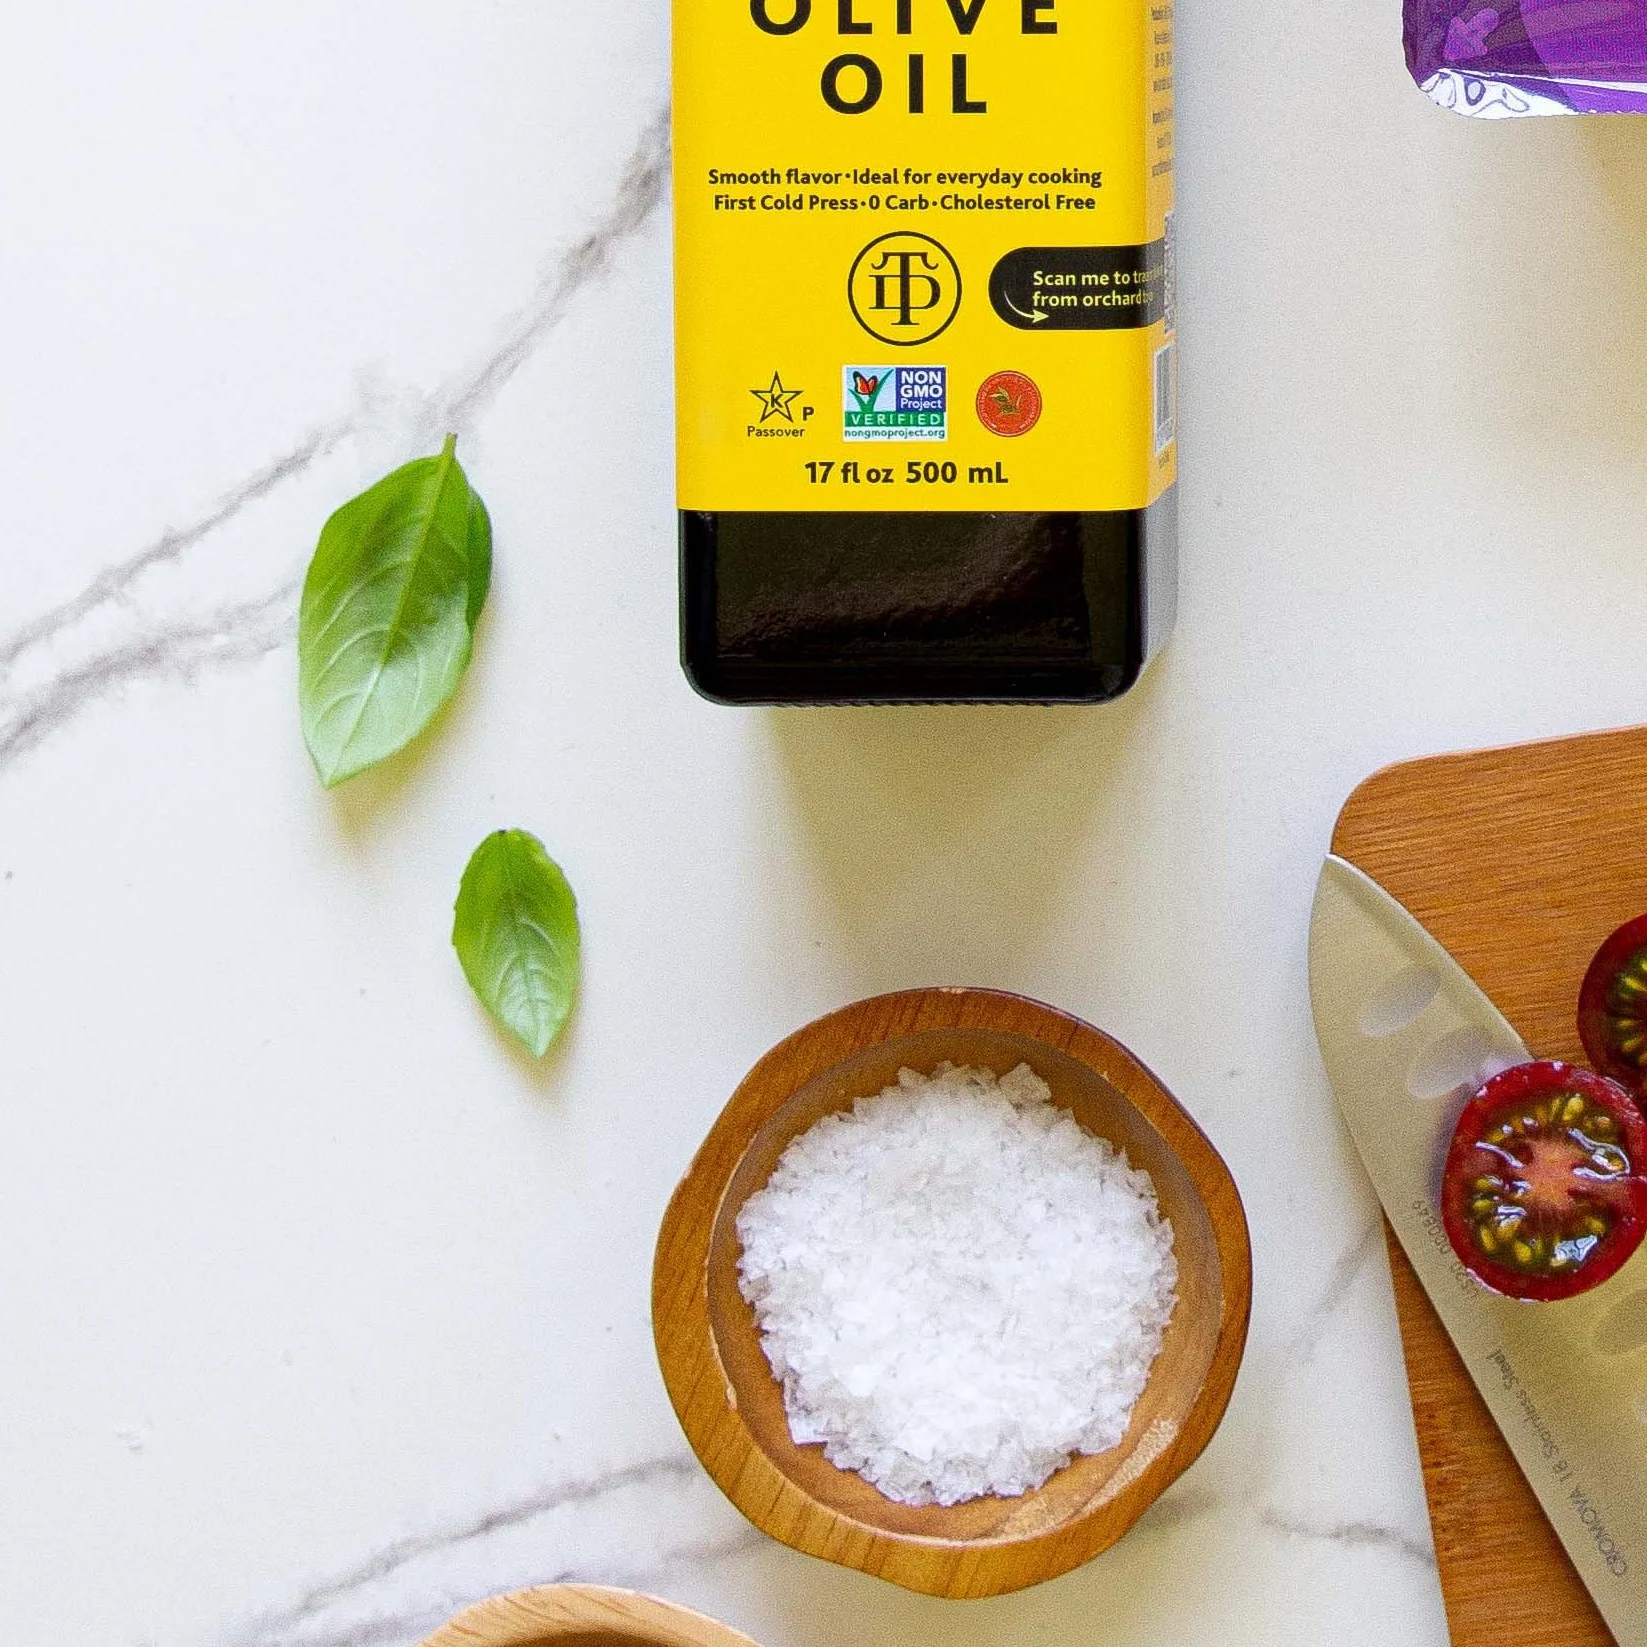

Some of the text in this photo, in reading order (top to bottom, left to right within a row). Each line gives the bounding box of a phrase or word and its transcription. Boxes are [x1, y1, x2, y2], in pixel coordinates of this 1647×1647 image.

[820, 53, 987, 115] OIL
[708, 168, 781, 186] Smooth
[903, 168, 932, 186] for
[936, 169, 1023, 189] everyday
[1028, 169, 1102, 188] cooking
[714, 194, 756, 211] First
[760, 194, 804, 211] Cold
[1055, 195, 1095, 211] Free
[1033, 271, 1076, 286] Scan
[1081, 274, 1109, 286] me
[1114, 271, 1131, 286] to
[1033, 291, 1077, 307] from
[1087, 289, 1142, 306] orchard
[901, 371, 941, 384] NON
[901, 385, 942, 398] GMO
[770, 394, 783, 408] K
[900, 398, 942, 411] Project
[803, 407, 814, 421] P
[851, 414, 940, 425] VERIFIED
[748, 426, 806, 438] Passover
[845, 428, 945, 440] nongmoproject.org
[805, 461, 1008, 484] 17 fl oz 500 mL
[1485, 1348, 1520, 1391] Steel
[1508, 1387, 1561, 1460] Stainless
